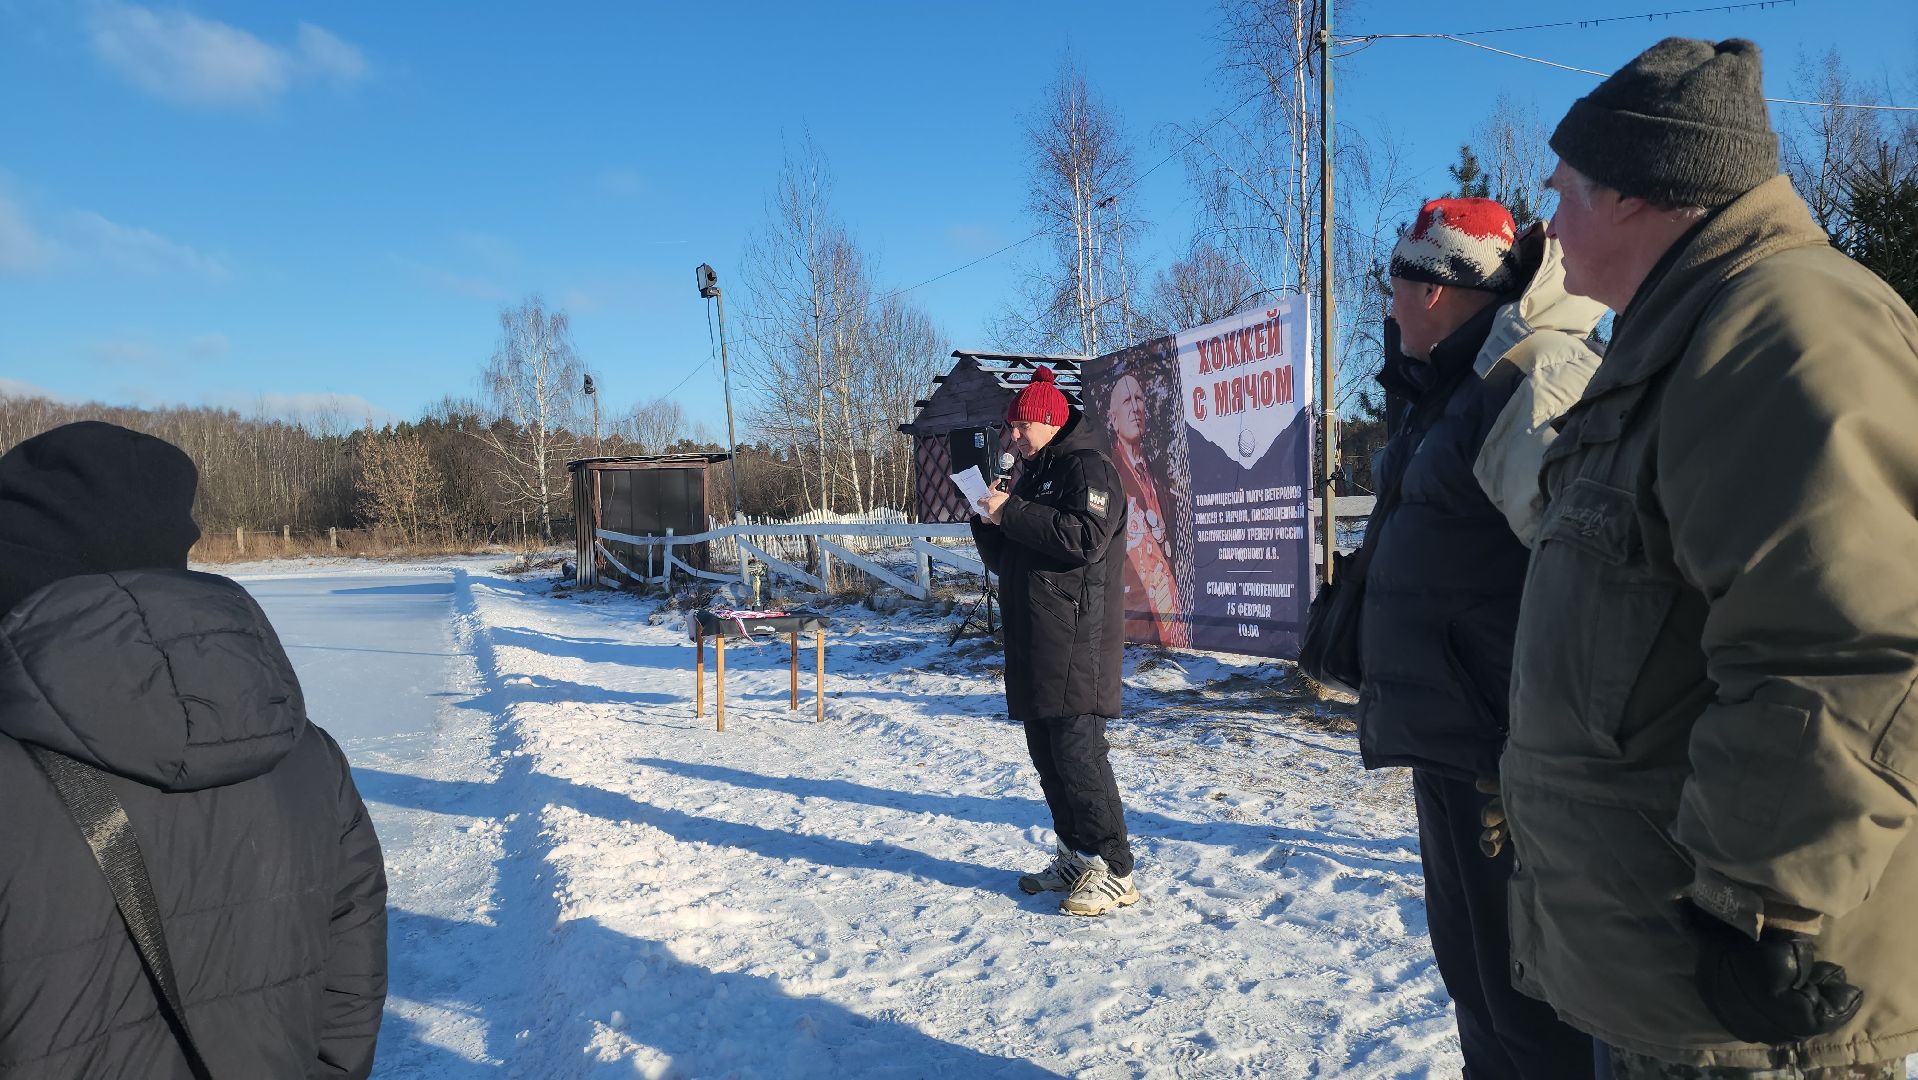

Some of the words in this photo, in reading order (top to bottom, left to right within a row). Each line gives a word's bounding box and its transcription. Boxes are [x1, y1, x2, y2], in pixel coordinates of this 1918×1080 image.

[1196, 309, 1283, 375] ХОККЕЙ
[1193, 386, 1206, 421] С
[1214, 365, 1294, 417] МЯЧОМ
[1195, 488, 1245, 507] ТОВАРИЩЕСКИЙ
[1246, 489, 1264, 503] МАТЧ
[1264, 485, 1302, 501] ВЕТЕРАНОВ
[1219, 511, 1224, 524] С
[1197, 528, 1246, 542] ЗАСЛУЖЕННОМУ
[1246, 527, 1275, 541] ТРЕНЕРУ
[1274, 526, 1304, 540] РОССИИ
[1206, 581, 1237, 598] СТАДИОН
[1226, 602, 1236, 616] 15
[1237, 603, 1272, 619] ФЕВРАЛЯ
